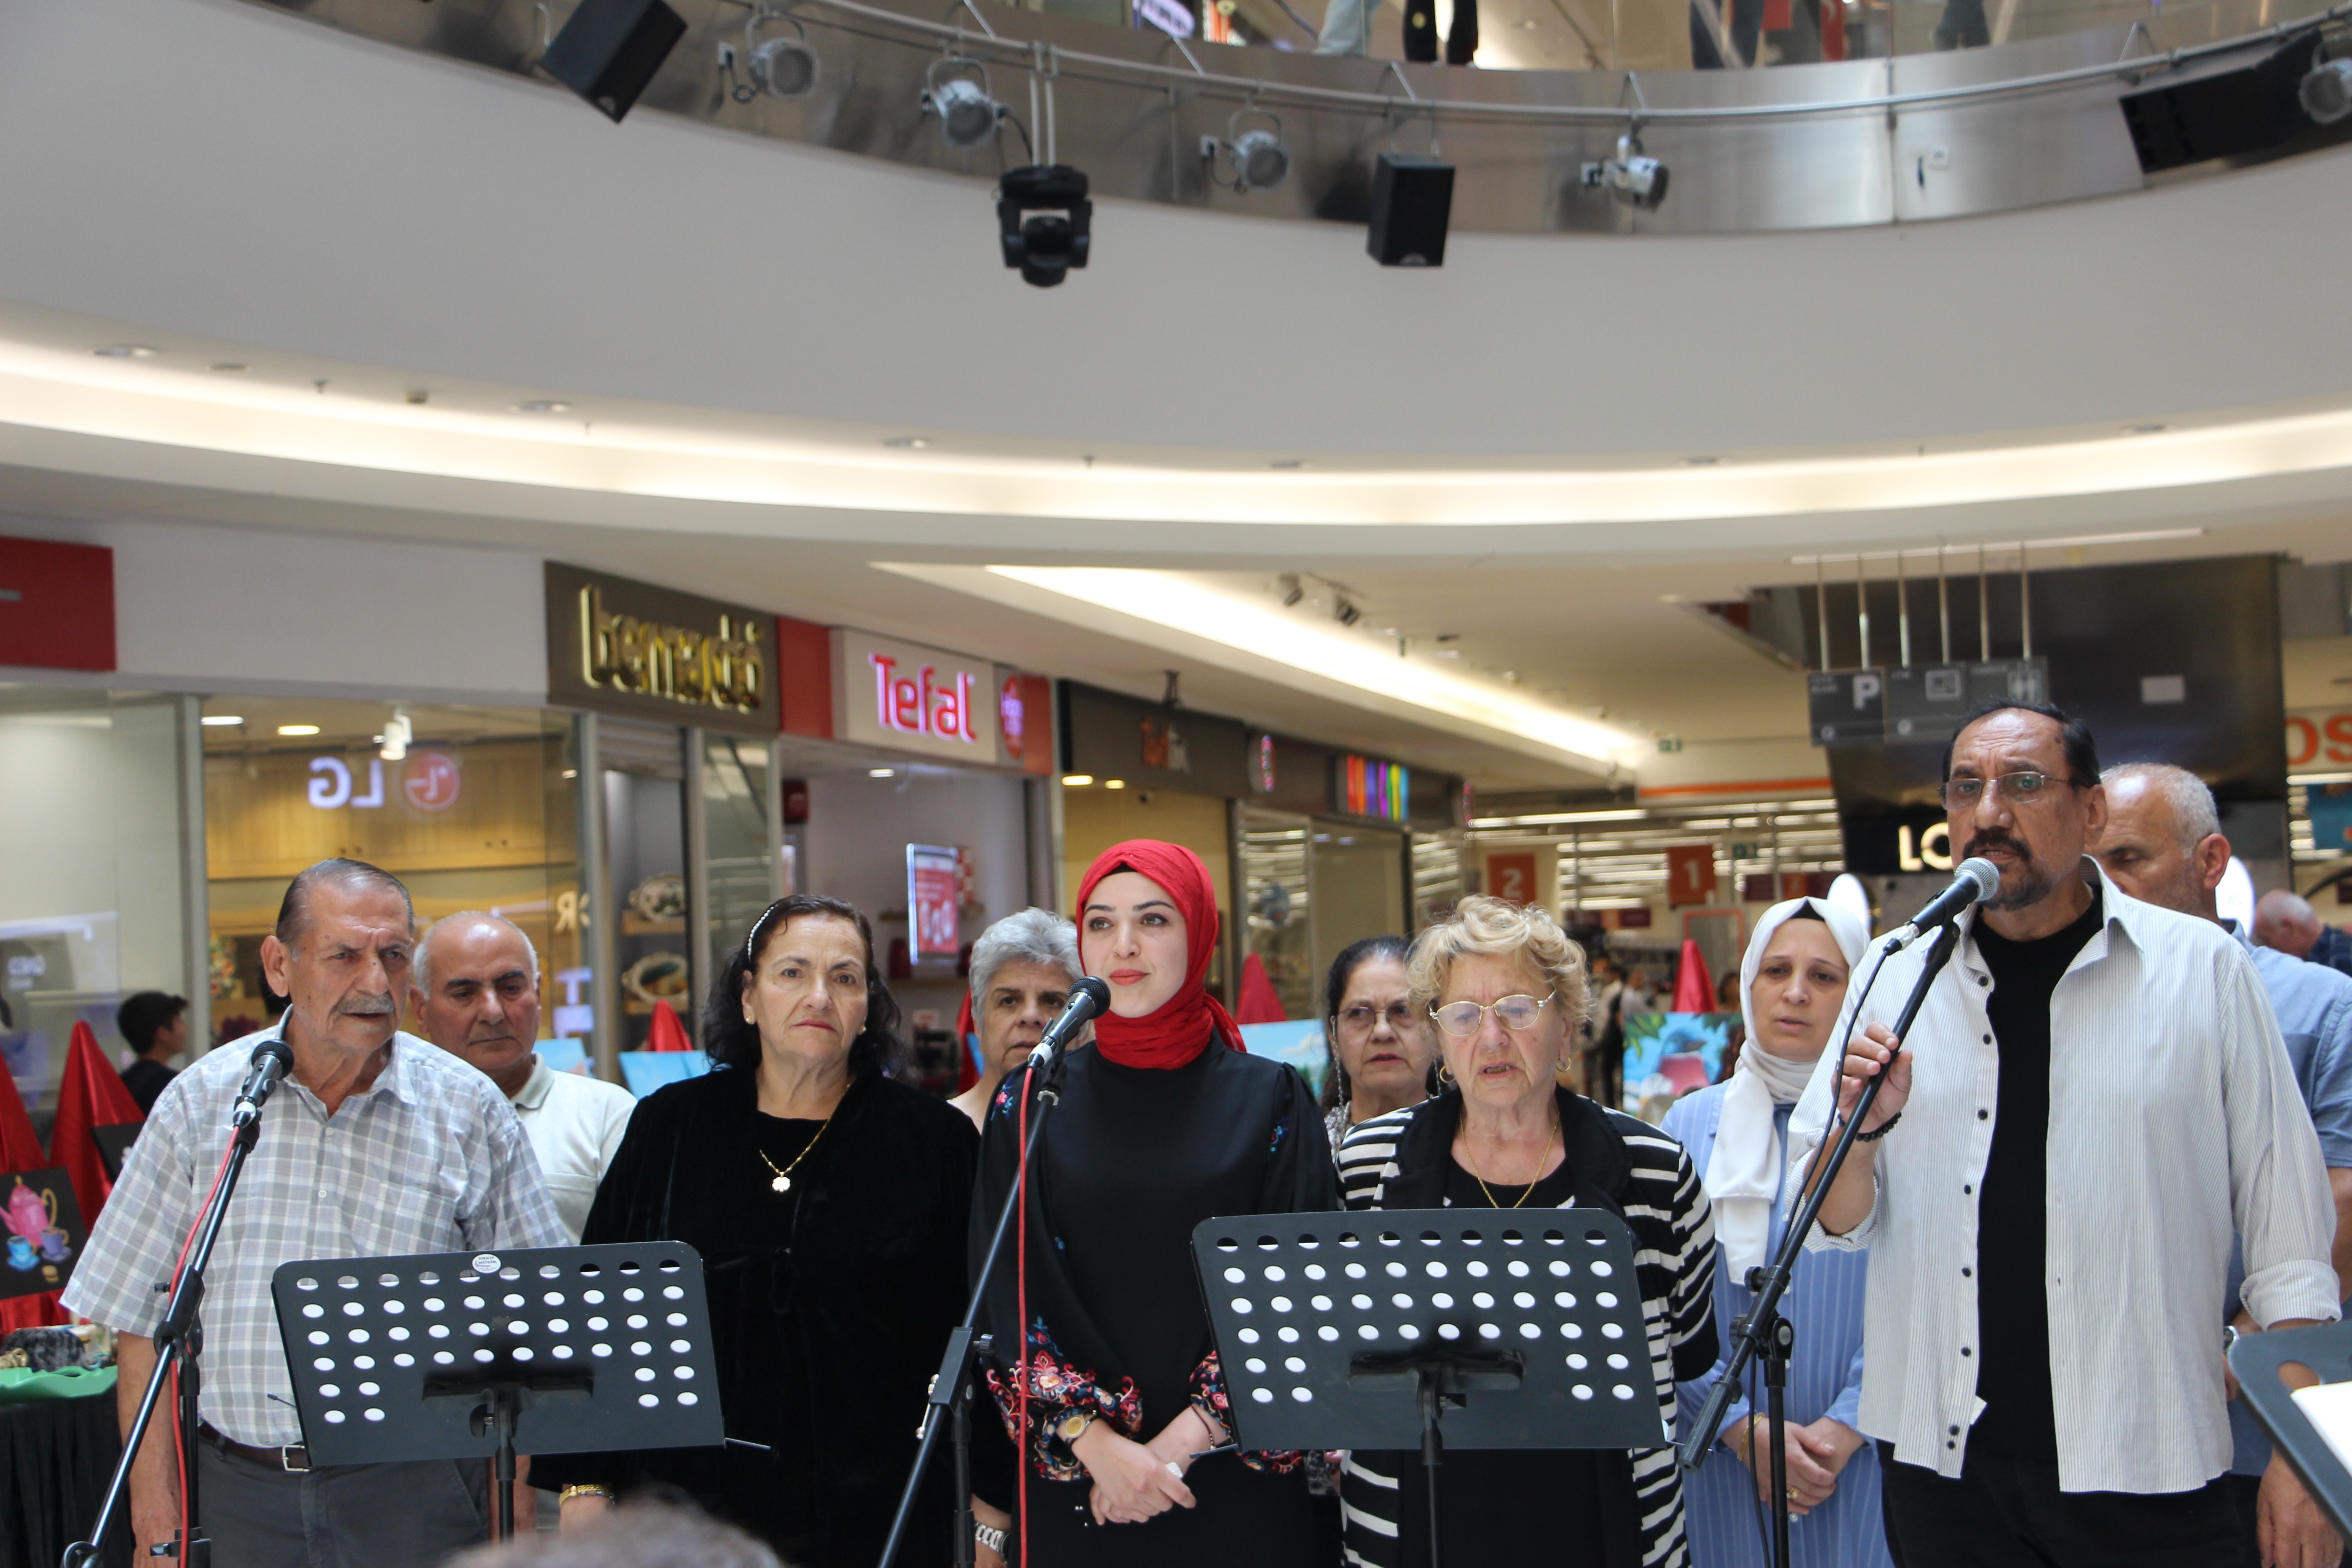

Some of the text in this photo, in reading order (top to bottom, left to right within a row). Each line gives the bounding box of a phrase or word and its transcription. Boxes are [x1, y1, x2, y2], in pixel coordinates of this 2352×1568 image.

[580, 584, 765, 715] bernardo
[868, 652, 978, 745] Tefal
[1853, 675, 1880, 710] P
[1502, 867, 1523, 898] 2
[1685, 858, 1700, 891] 1
